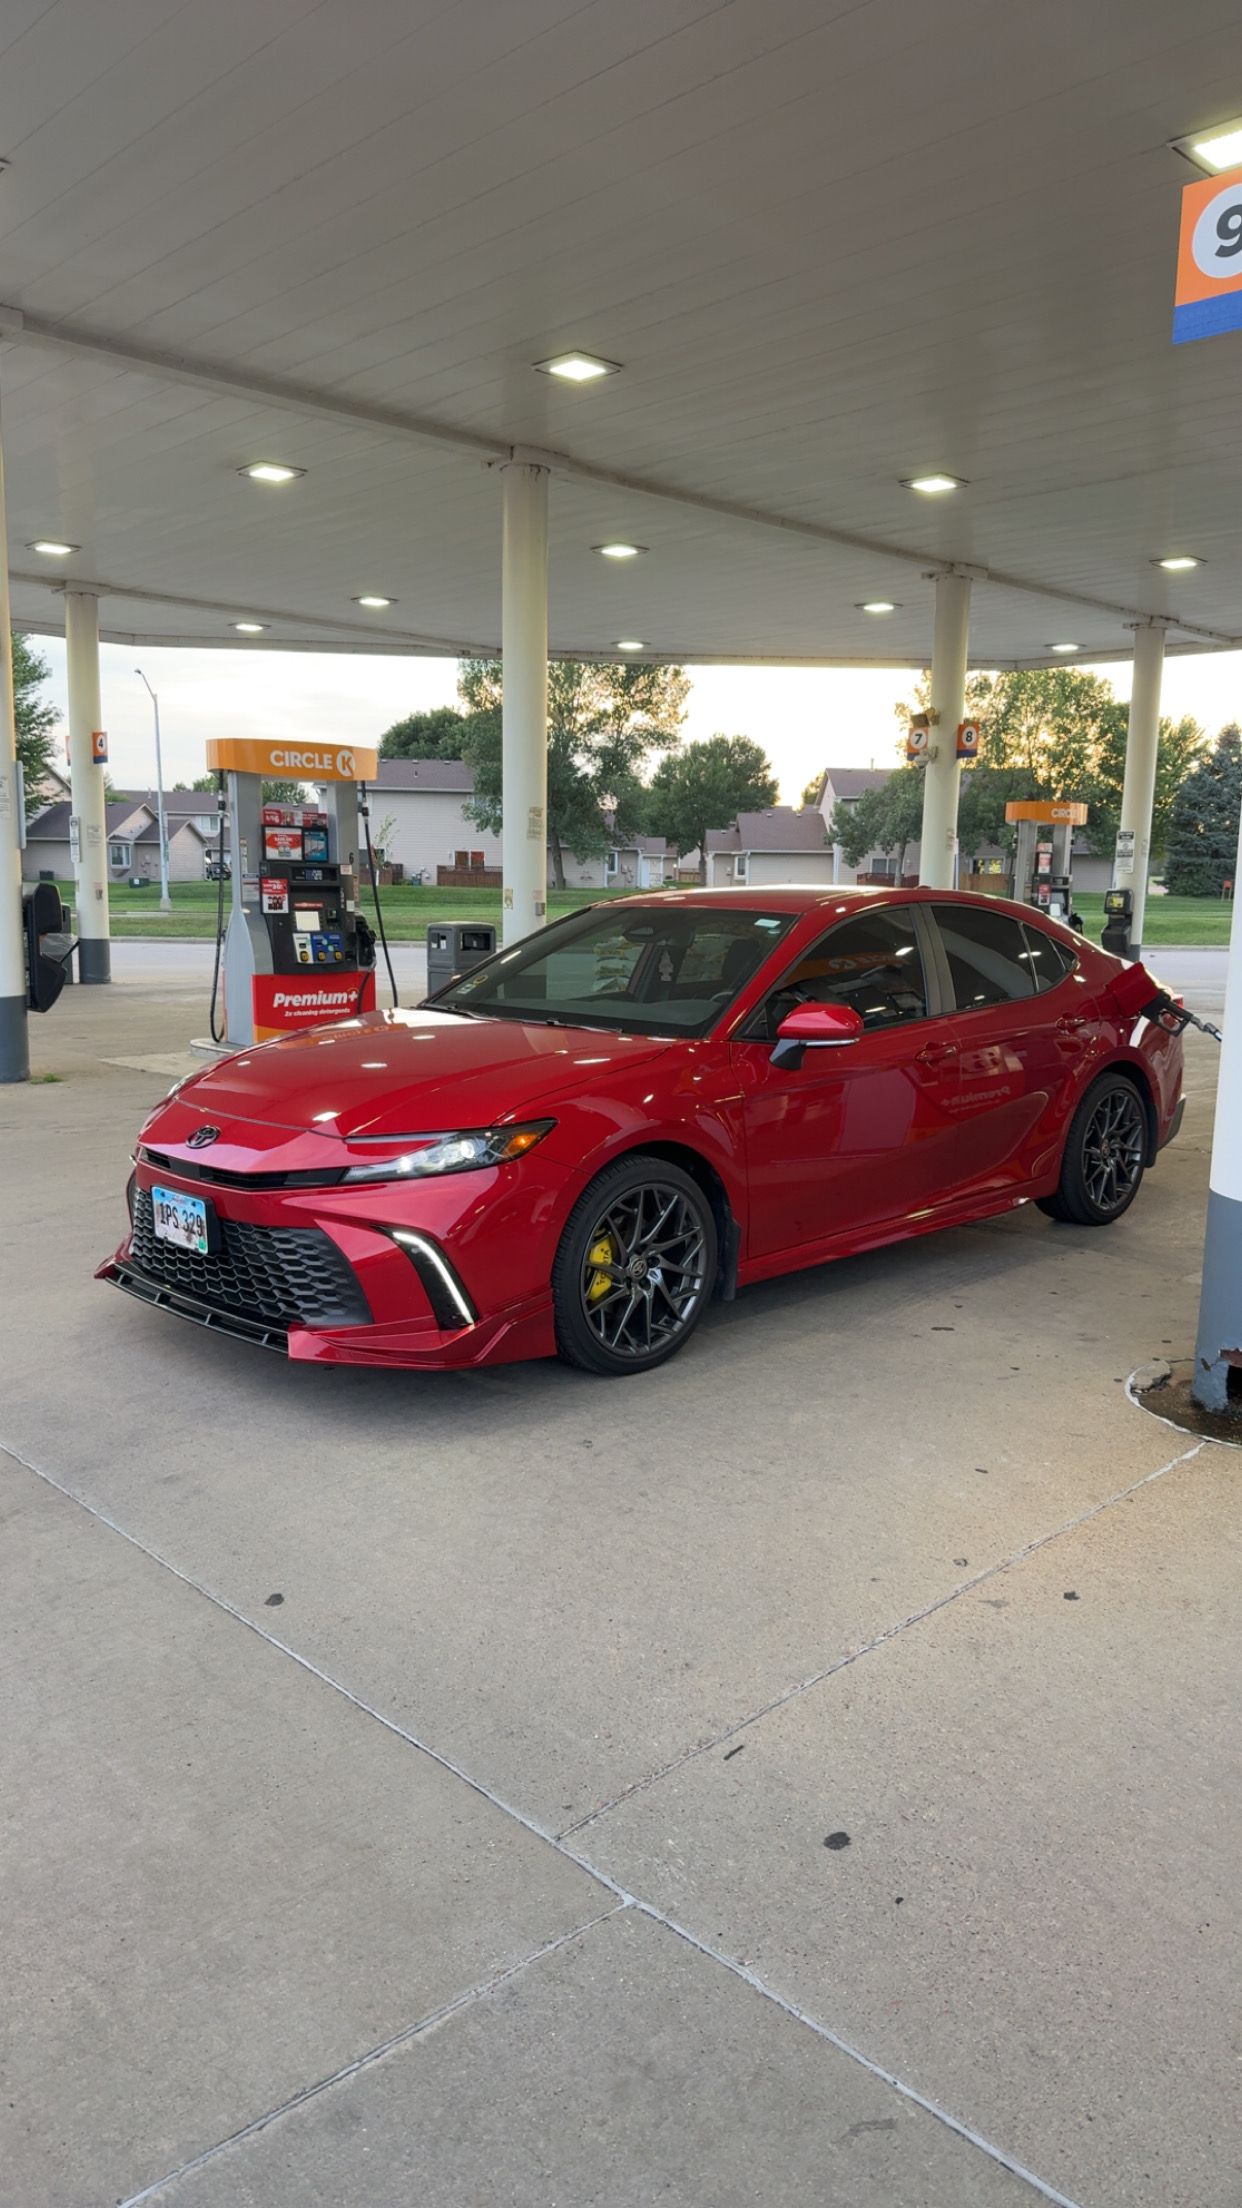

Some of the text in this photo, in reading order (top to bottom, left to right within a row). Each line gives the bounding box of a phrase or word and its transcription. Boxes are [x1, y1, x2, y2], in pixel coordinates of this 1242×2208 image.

[1214, 203, 1242, 258] 9
[98, 736, 104, 749] 4
[914, 732, 923, 745] 7
[965, 730, 973, 743] 8
[269, 749, 333, 770] CIRCLE
[293, 1009, 319, 1018] cleaning
[319, 1007, 351, 1016] detergents
[182, 1209, 203, 1237] 329
